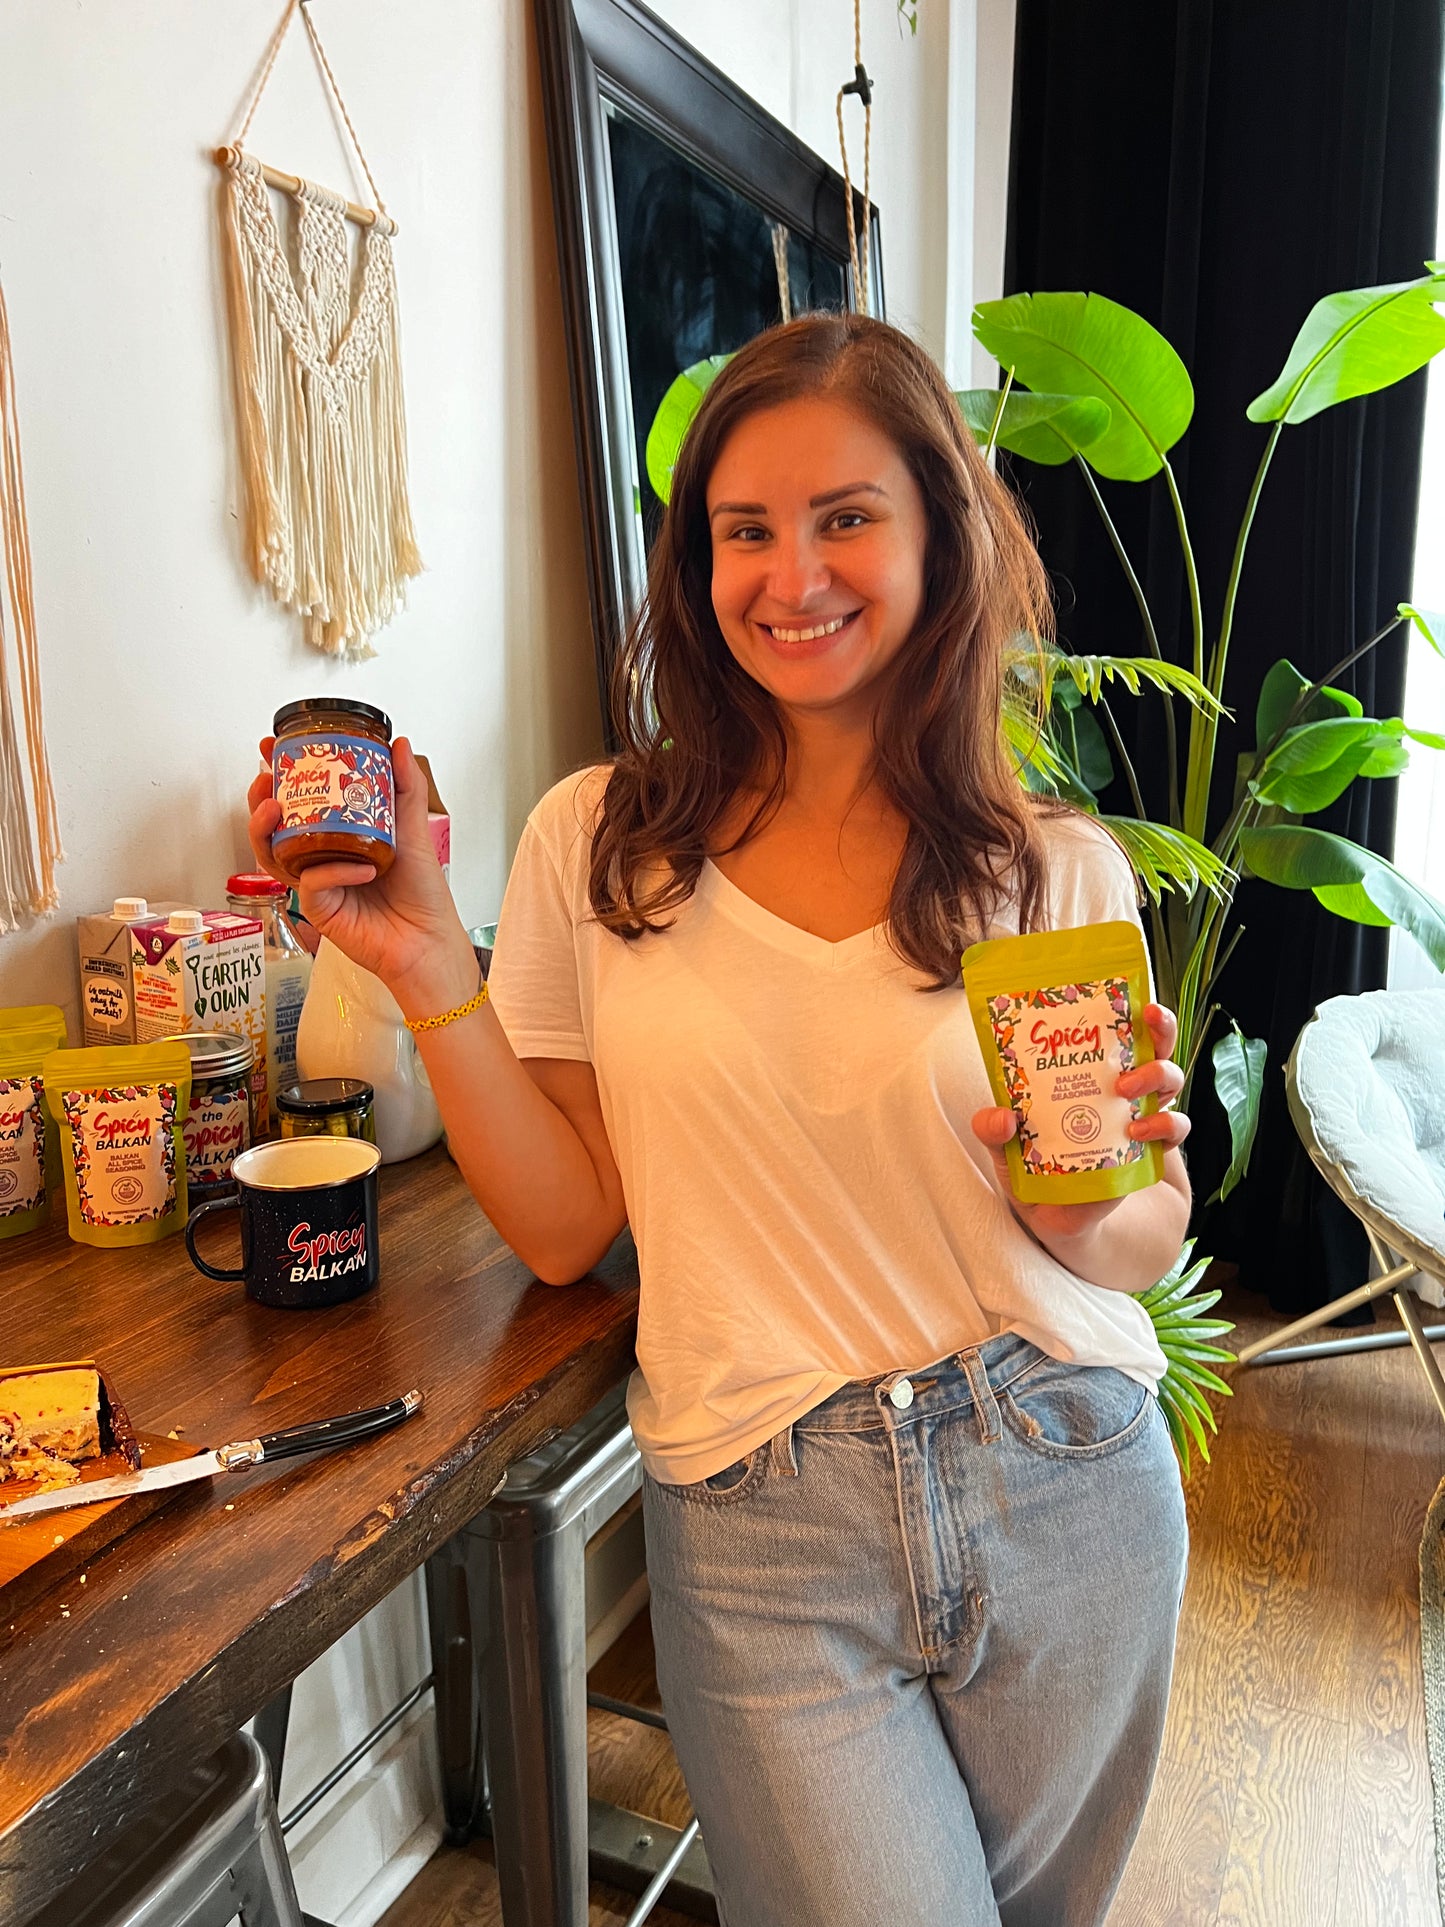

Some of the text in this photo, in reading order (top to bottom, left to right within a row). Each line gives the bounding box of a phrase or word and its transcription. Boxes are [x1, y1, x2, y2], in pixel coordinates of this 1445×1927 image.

[285, 768, 330, 791] Spicy
[286, 786, 331, 801] BALKAN
[202, 953, 262, 991] EARTH'S
[90, 994, 119, 1008] okay for
[210, 982, 250, 1013] OWN
[93, 1007, 123, 1020] pockets?
[1030, 1019, 1101, 1057] Spicy
[1036, 1049, 1104, 1071] BALKAN
[1056, 1072, 1092, 1085] BALKAN
[1053, 1080, 1097, 1093] ALL SPICE
[1051, 1088, 1102, 1102] SEASONING
[201, 1111, 223, 1122] the
[93, 1111, 151, 1141] Spicy
[95, 1136, 152, 1151] BALKAN
[182, 1117, 244, 1157] Spicy
[110, 1153, 140, 1161] BALKAN
[122, 1158, 143, 1166] SPICE
[105, 1164, 146, 1174] SEASONING
[287, 1222, 366, 1269] Spicy
[289, 1250, 367, 1283] BALKAN
